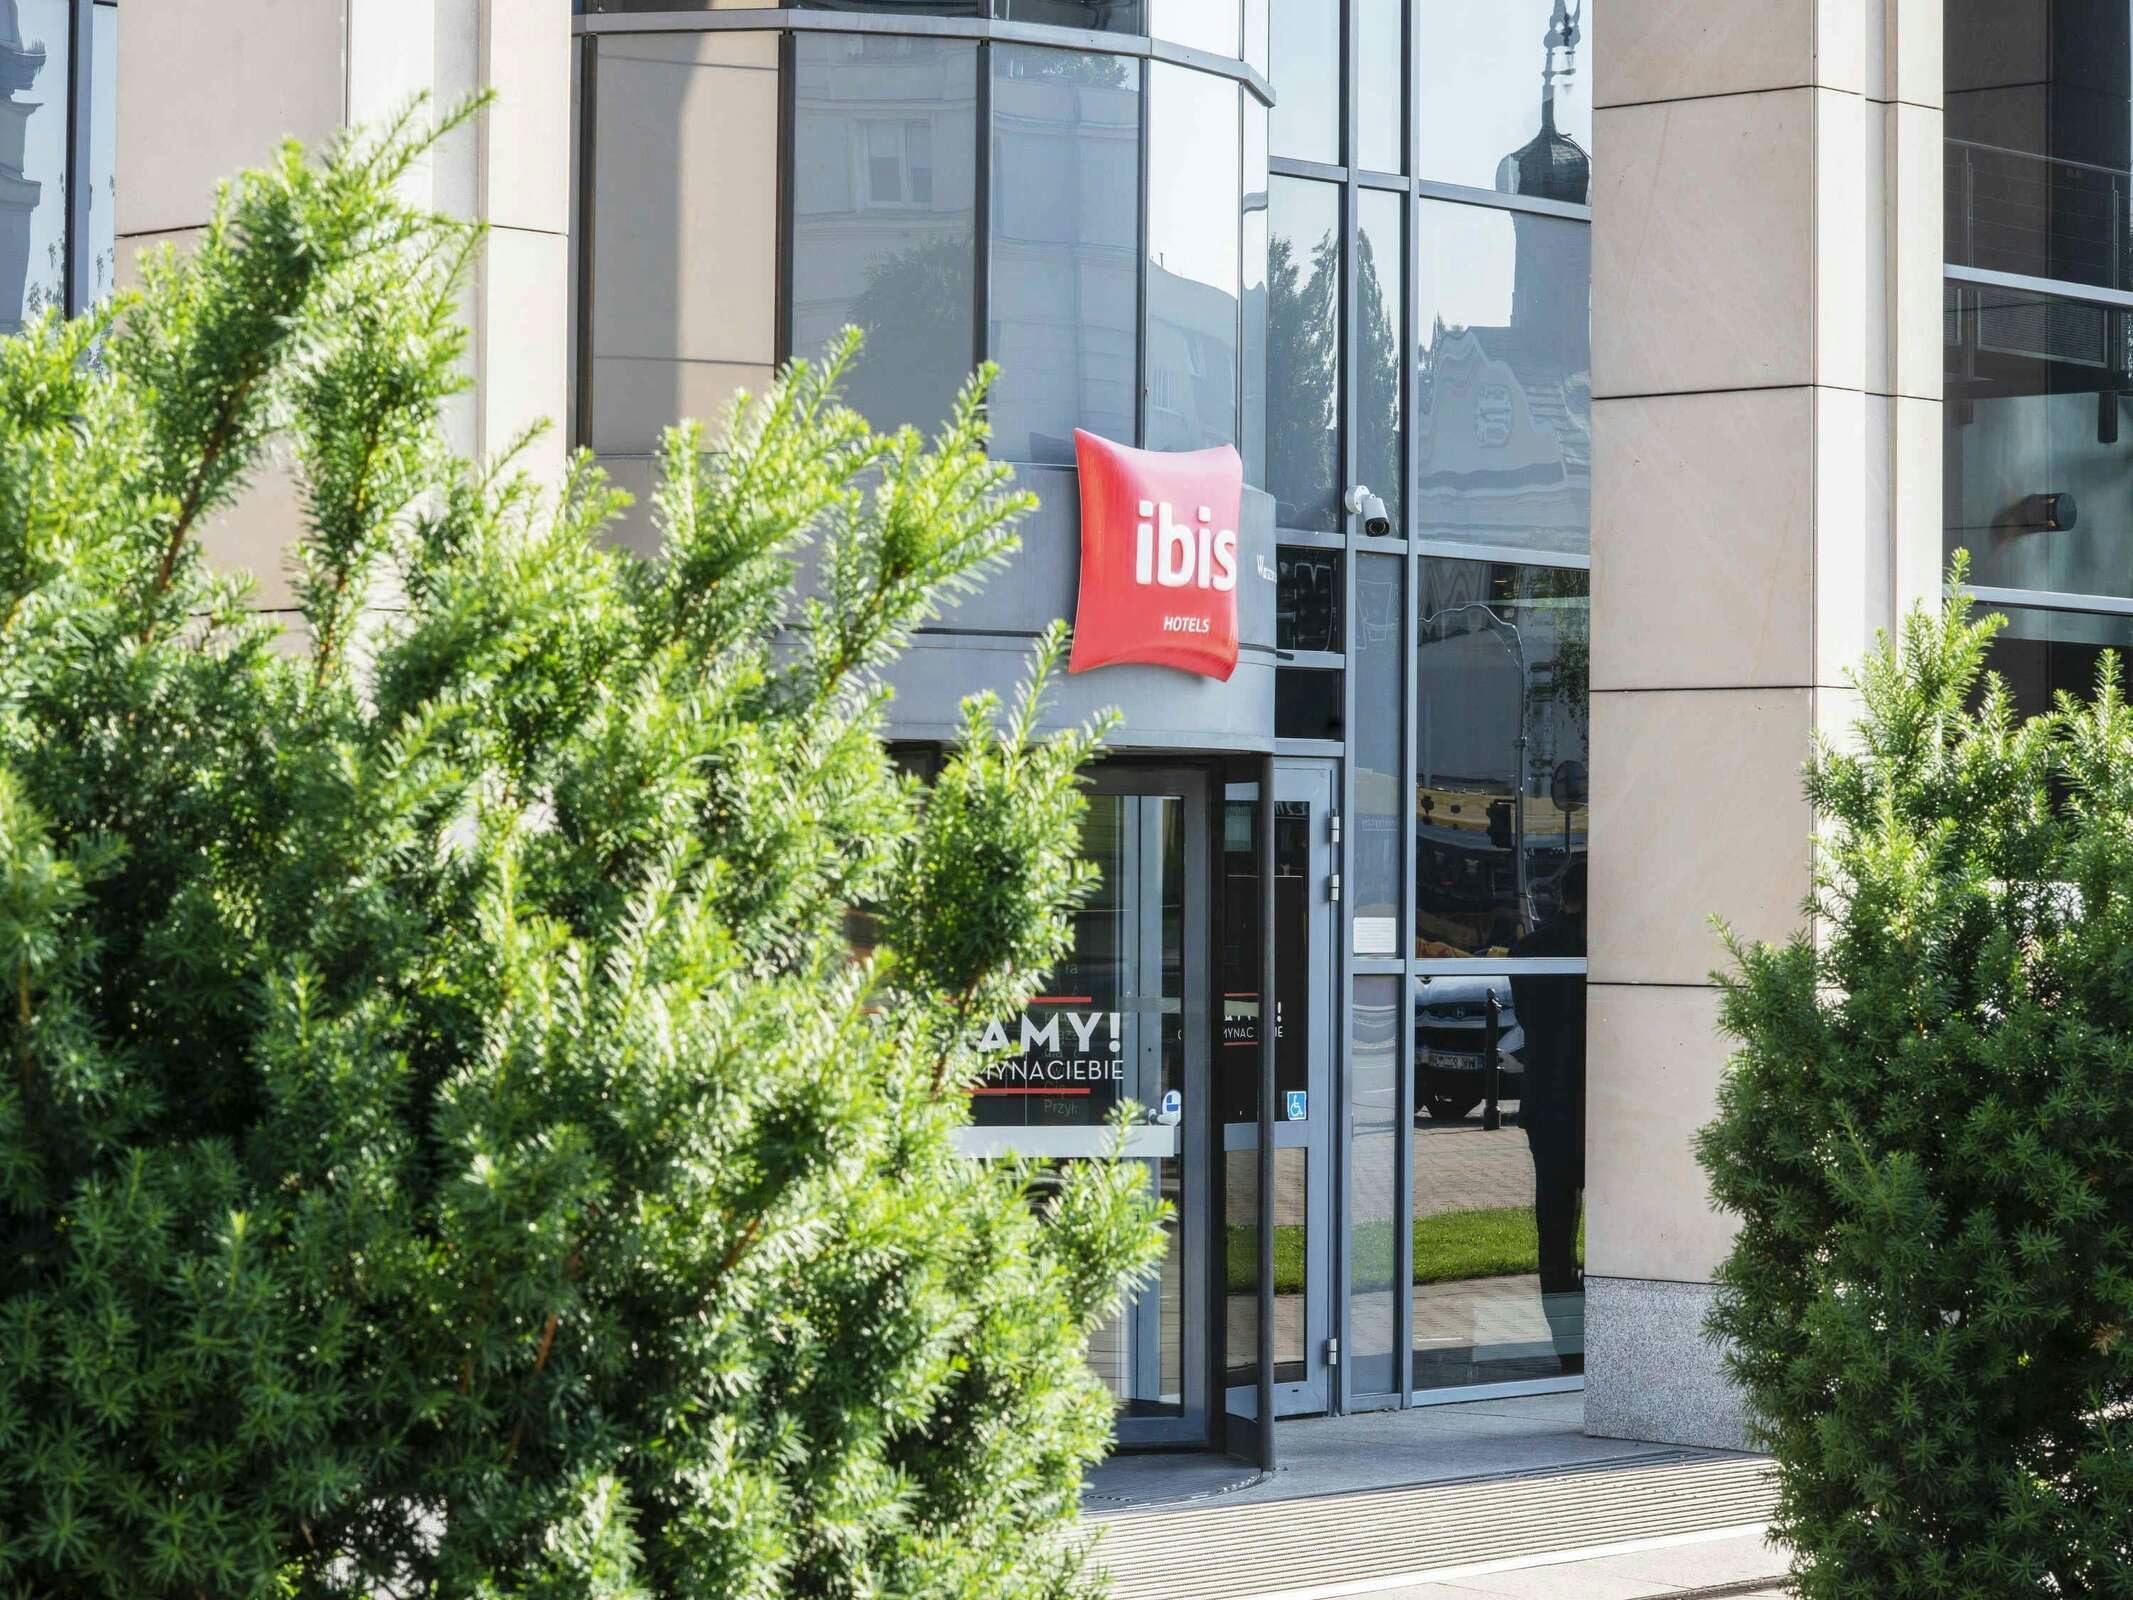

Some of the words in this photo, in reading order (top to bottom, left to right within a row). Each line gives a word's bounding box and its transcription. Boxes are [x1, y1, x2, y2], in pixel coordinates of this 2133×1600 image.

[1136, 500, 1237, 591] ibis
[1163, 616, 1210, 633] HOTELS
[980, 1012, 1121, 1052] AMY!
